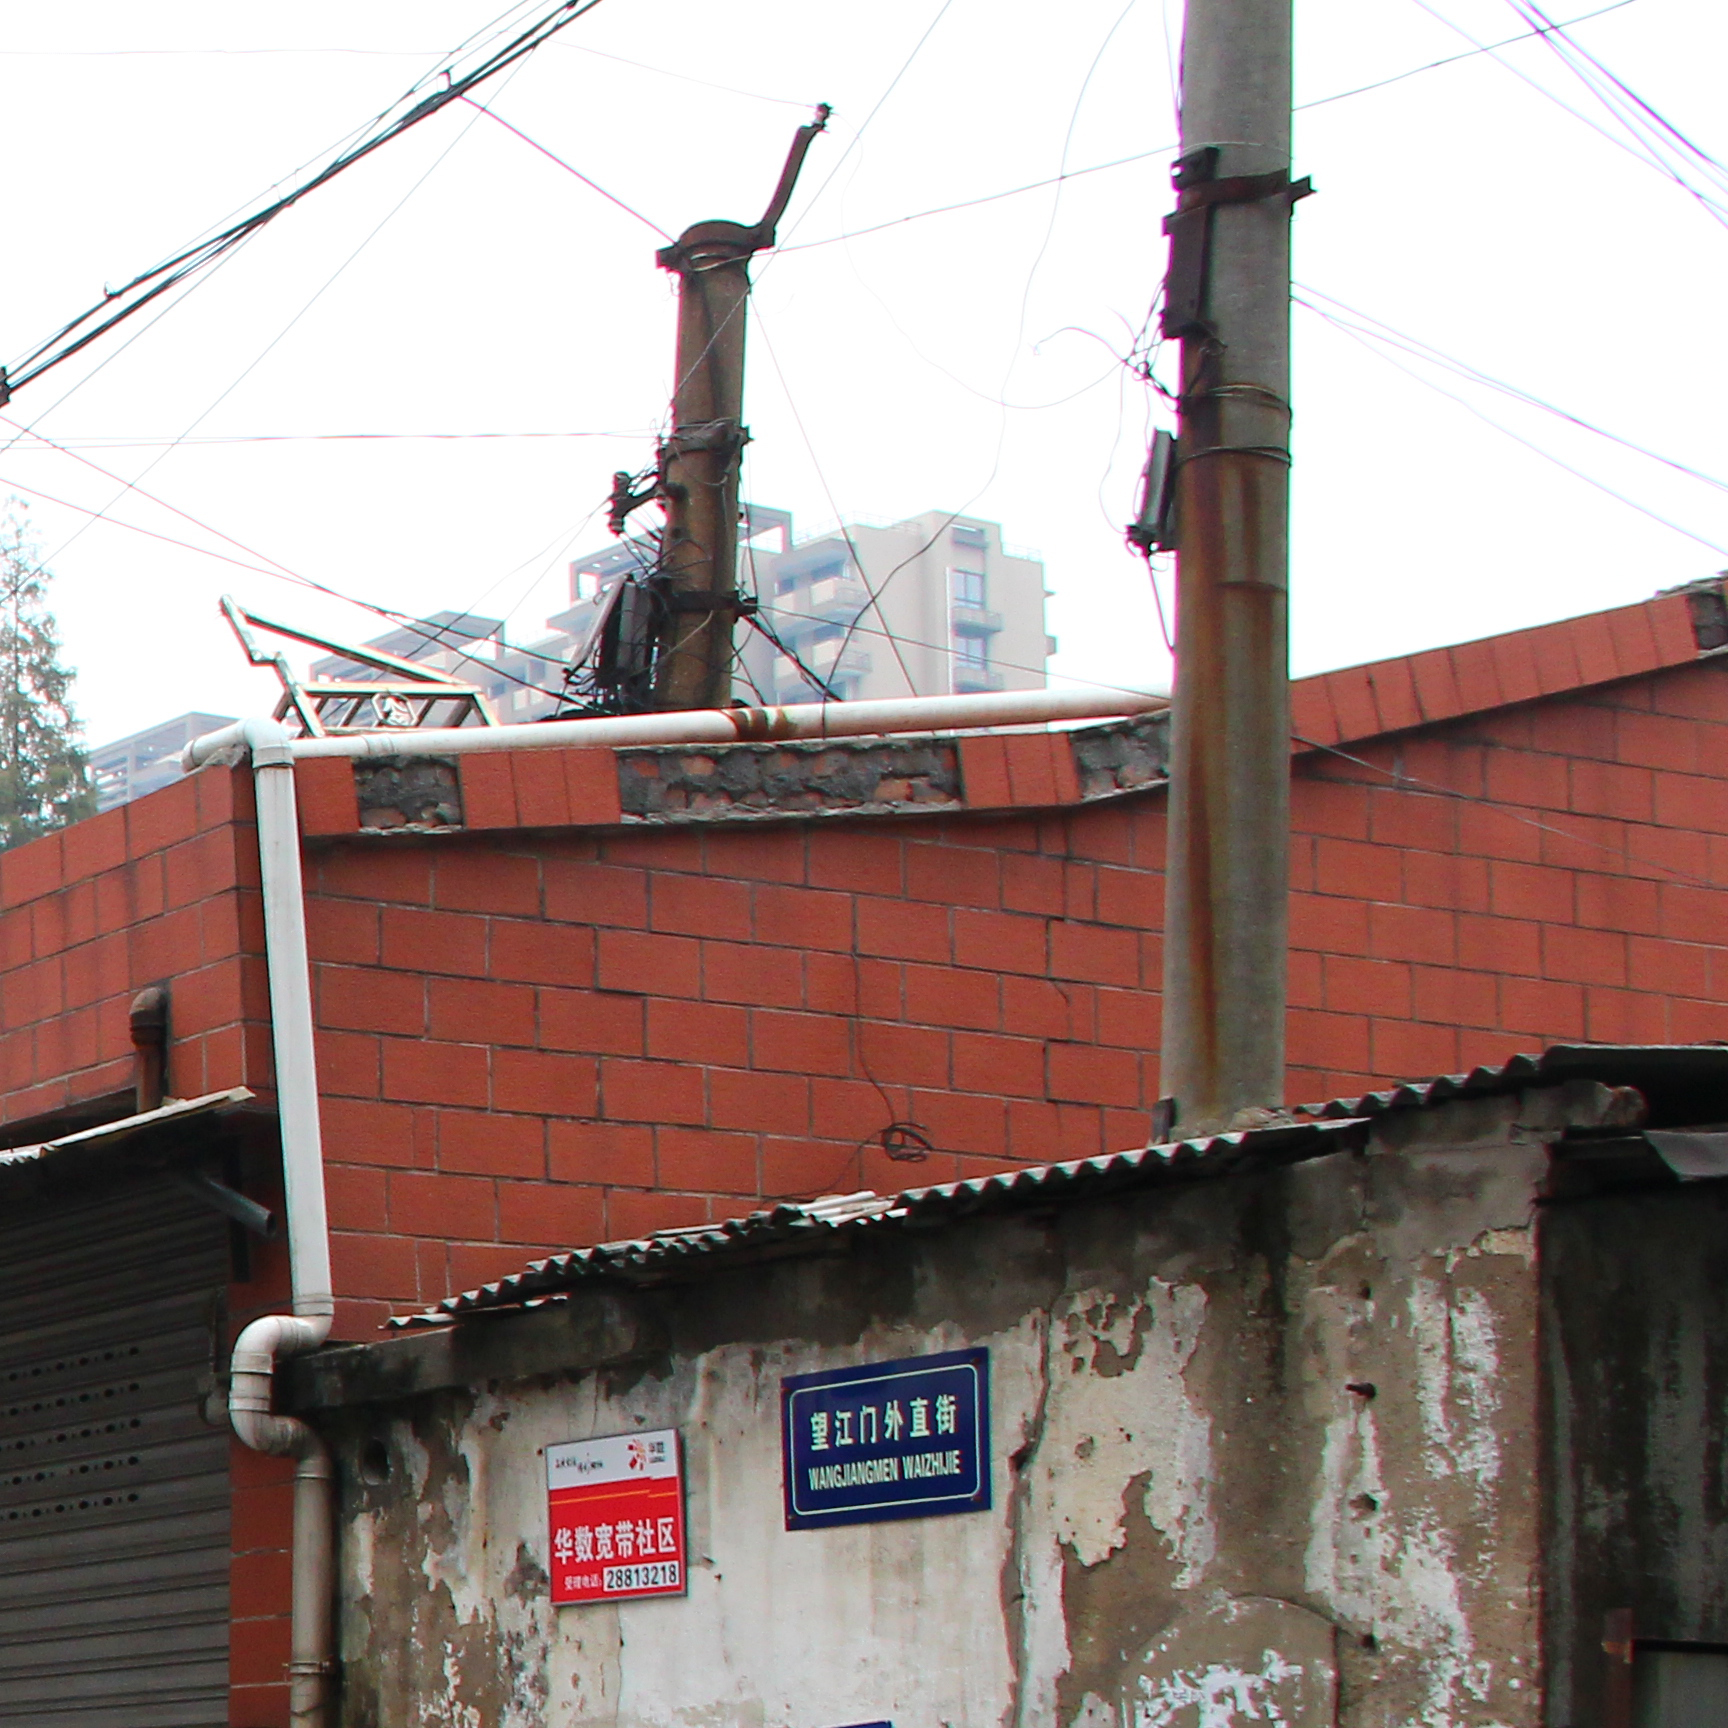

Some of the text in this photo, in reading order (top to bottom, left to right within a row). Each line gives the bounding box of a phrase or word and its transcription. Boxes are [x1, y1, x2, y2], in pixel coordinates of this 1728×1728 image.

[810, 1394, 956, 1451] 望江门外直街
[808, 1450, 961, 1491] WANGJIANGMEN WAIZHIJIE
[554, 1516, 677, 1566] 华数宽带社区
[606, 1563, 679, 1590] 28813218
